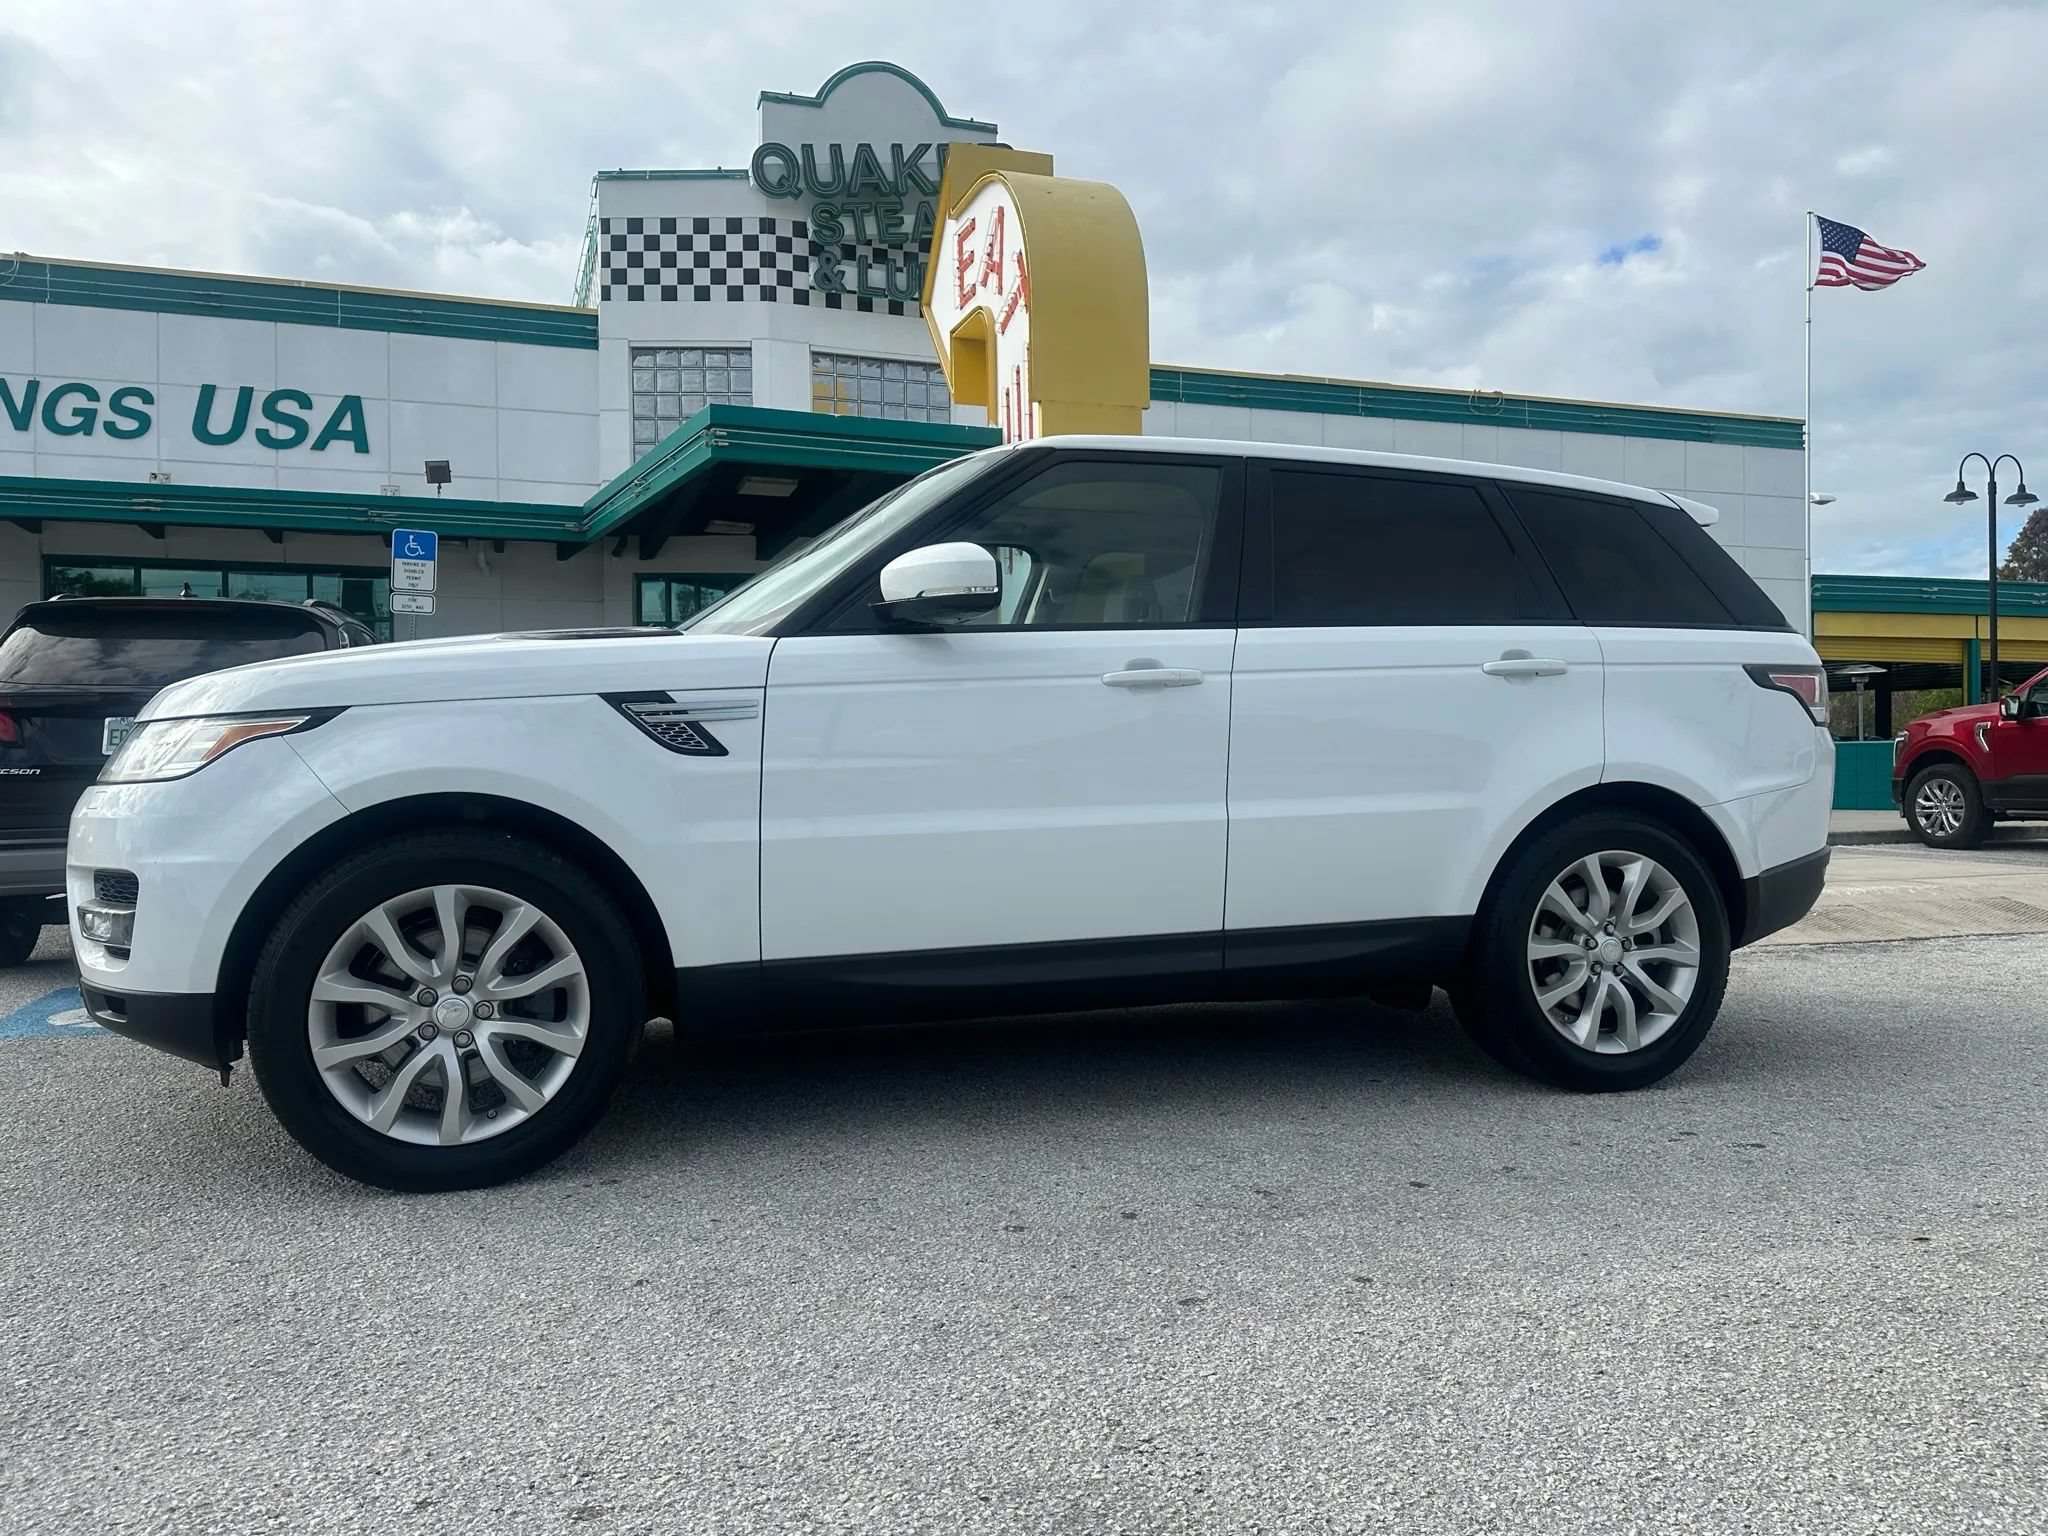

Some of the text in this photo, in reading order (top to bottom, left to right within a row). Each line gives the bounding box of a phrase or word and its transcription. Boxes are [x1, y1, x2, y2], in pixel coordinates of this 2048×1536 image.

[751, 142, 950, 200] QUAK
[811, 201, 936, 245] STEA
[813, 250, 928, 301] & LU
[953, 205, 1030, 335] EAT
[191, 383, 370, 454] USA
